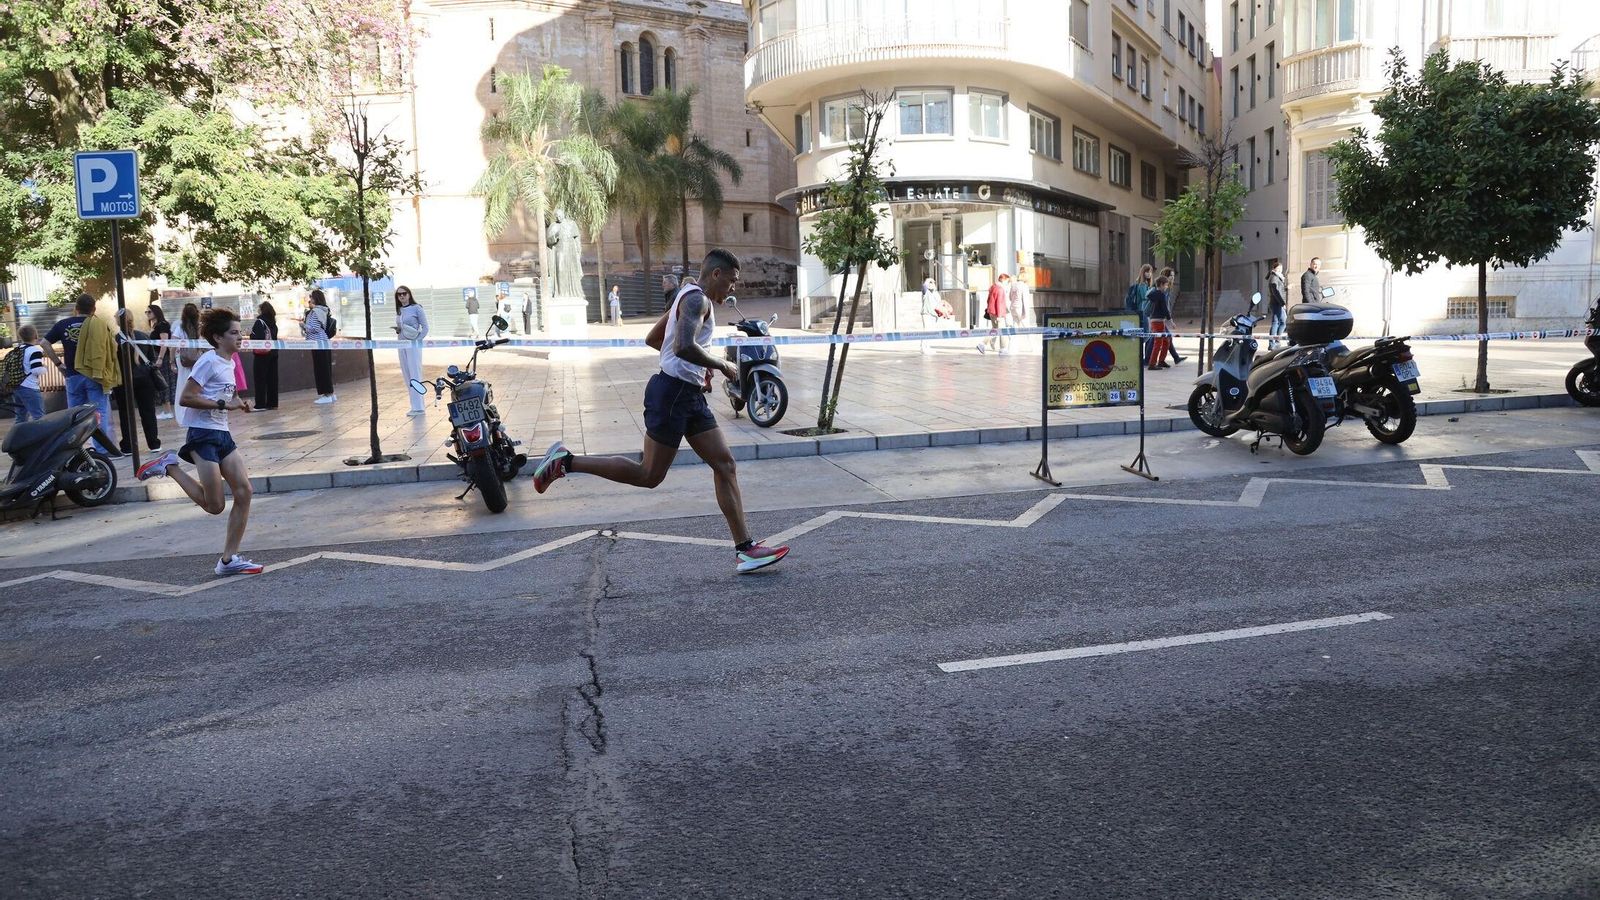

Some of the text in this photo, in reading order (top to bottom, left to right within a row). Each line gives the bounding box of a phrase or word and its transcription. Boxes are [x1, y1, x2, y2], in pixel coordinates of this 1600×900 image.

[79, 158, 118, 211] P
[907, 187, 960, 200] ESTATE
[101, 202, 135, 212] MOTOS
[1051, 321, 1113, 329] POLICIA LOCAL
[1082, 381, 1117, 391] ESTACIONAR
[1049, 394, 1061, 403] LAS
[1084, 392, 1096, 401] DEL
[457, 400, 480, 413] 6492
[462, 410, 480, 421] LCD
[36, 474, 55, 492] YAMAHA
